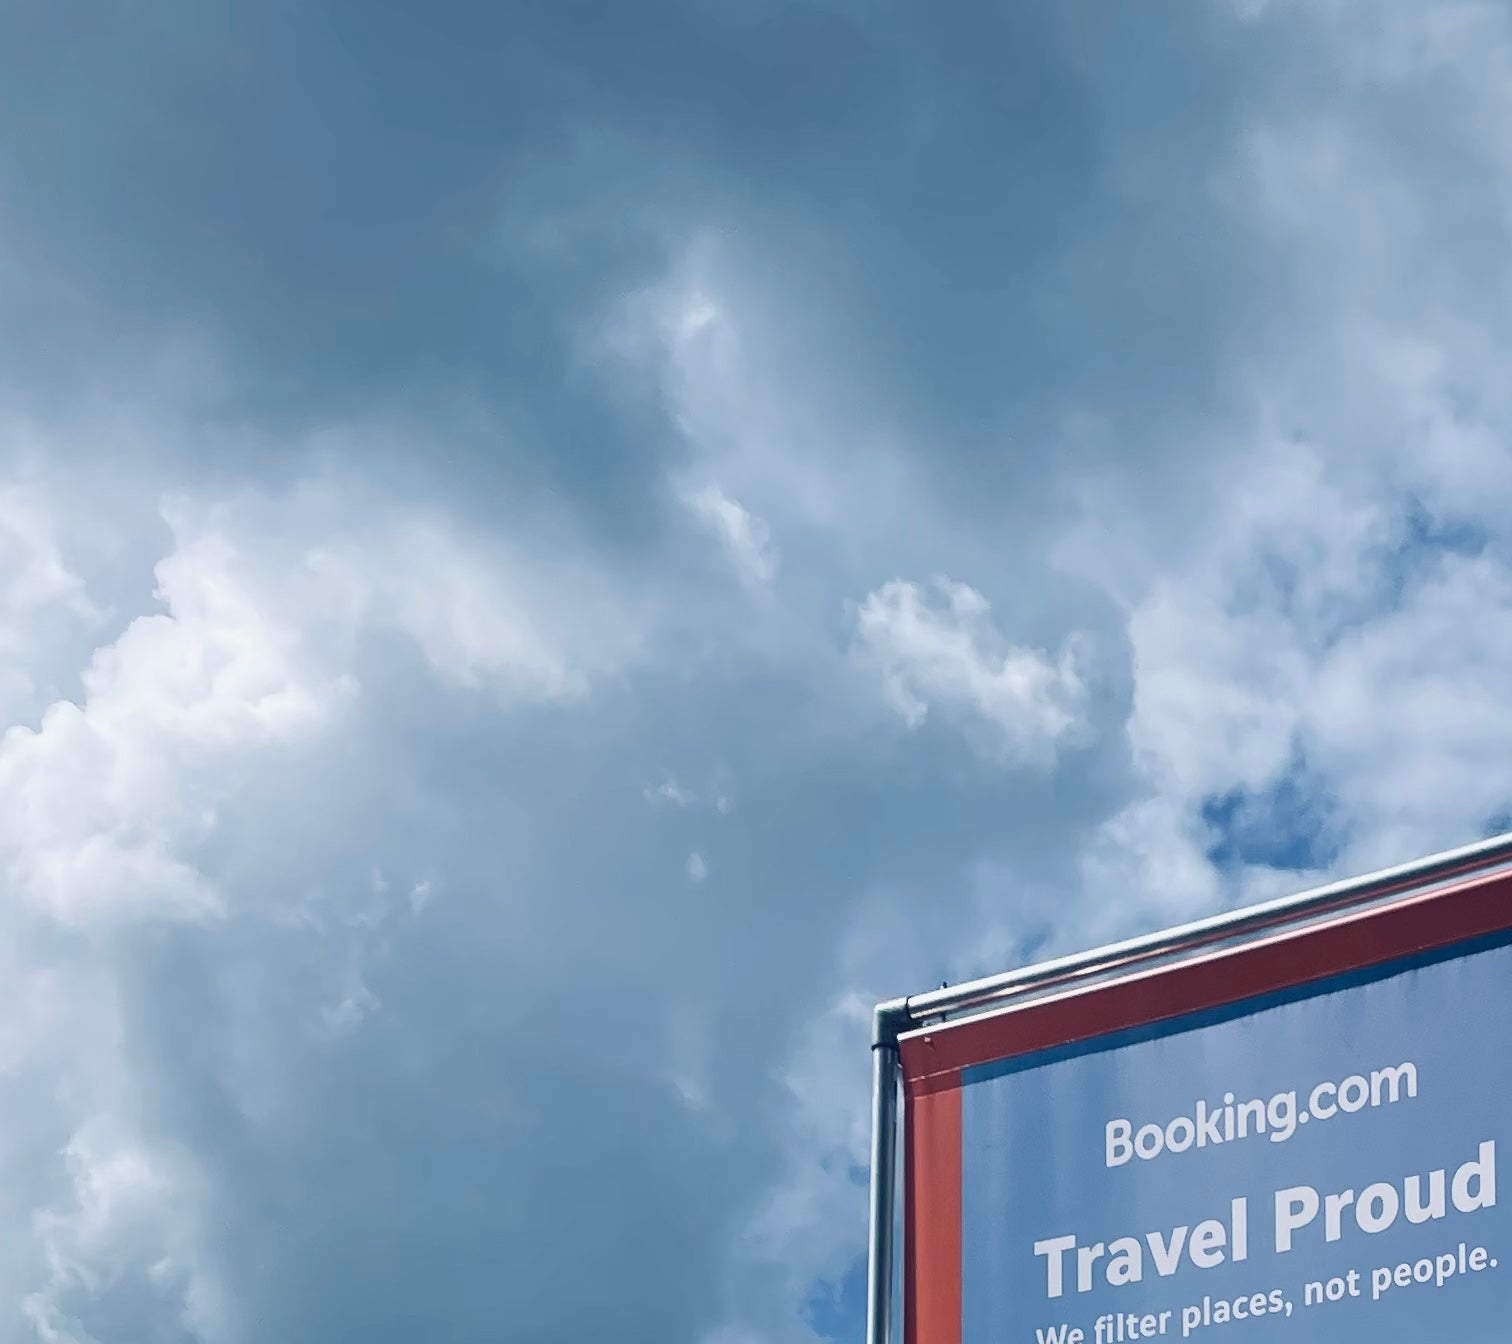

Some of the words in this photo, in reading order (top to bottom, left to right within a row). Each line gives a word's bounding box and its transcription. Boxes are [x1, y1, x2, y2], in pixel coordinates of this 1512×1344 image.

[1105, 1060, 1418, 1167] Booking.com
[1033, 1196, 1248, 1298] Travel
[1275, 1139, 1497, 1254] Proud
[1182, 1287, 1293, 1336] places,
[1304, 1267, 1361, 1306] not
[1371, 1242, 1499, 1300] people.
